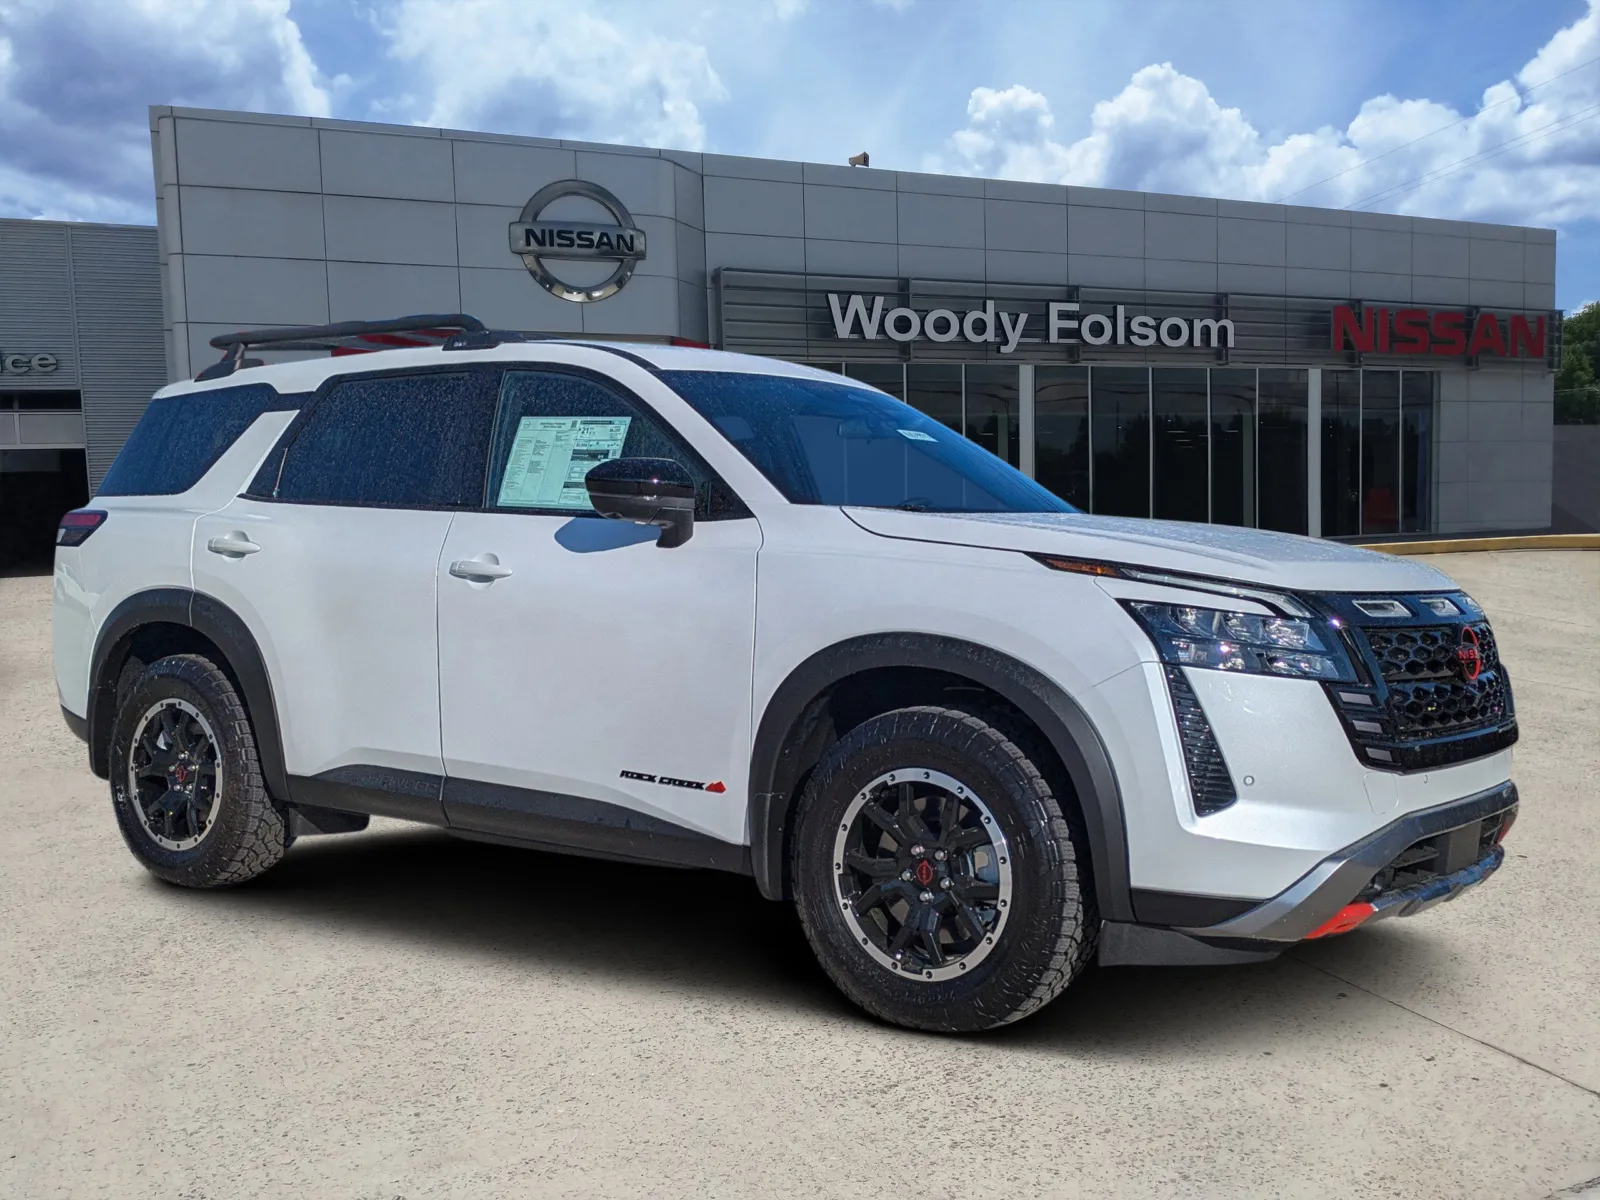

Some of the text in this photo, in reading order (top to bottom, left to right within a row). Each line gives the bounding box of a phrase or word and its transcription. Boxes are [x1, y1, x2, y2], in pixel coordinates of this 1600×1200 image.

[524, 228, 635, 253] NISSAN
[827, 293, 1546, 358] Woody Folsom NISSAN
[0, 352, 58, 374] ce
[619, 769, 706, 790] ROCK CREEK
